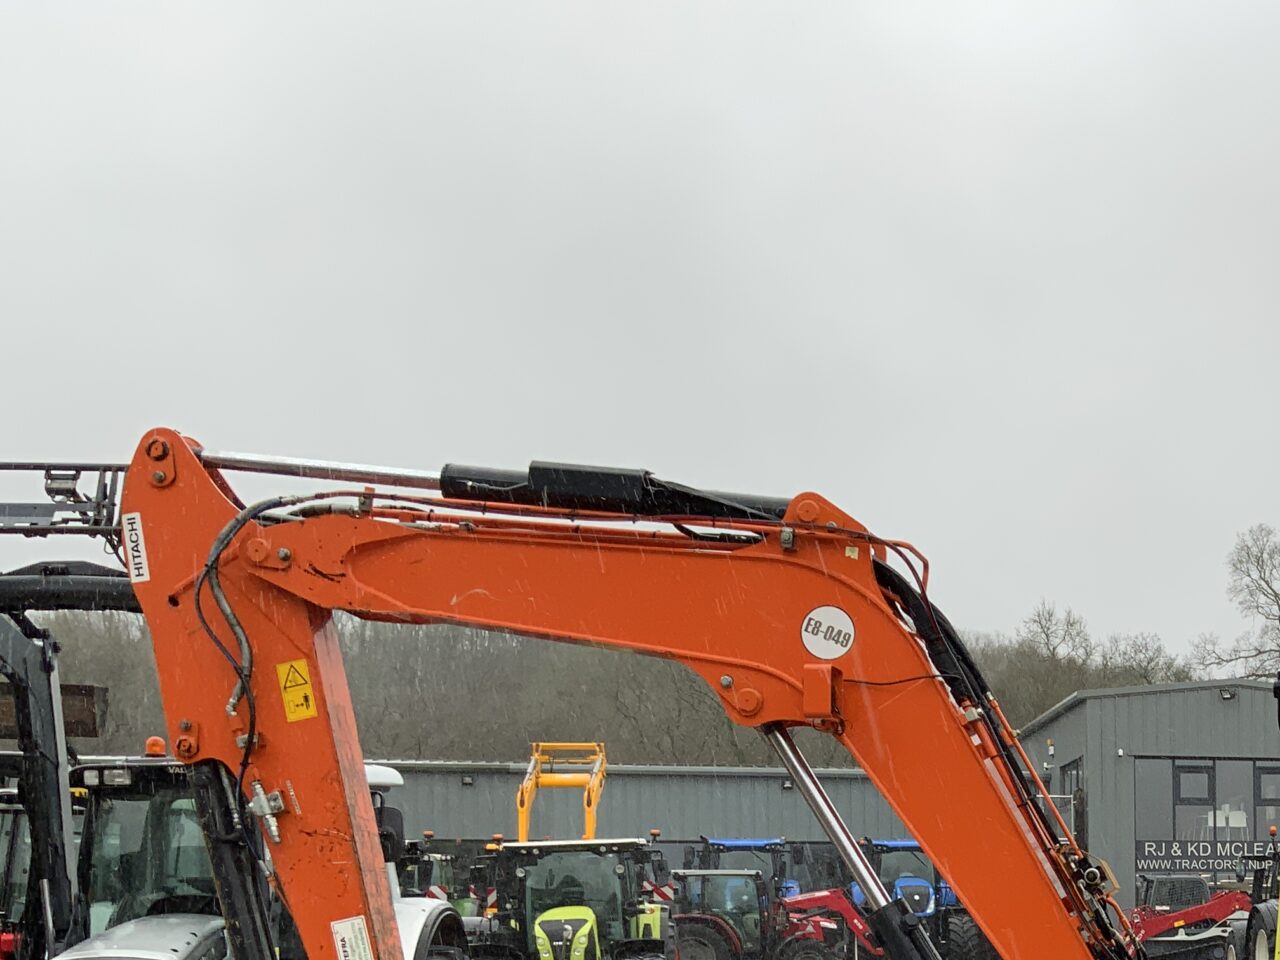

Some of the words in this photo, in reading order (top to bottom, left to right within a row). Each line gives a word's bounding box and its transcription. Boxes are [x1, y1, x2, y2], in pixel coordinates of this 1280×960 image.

[127, 517, 144, 577] HITACHI
[804, 617, 851, 648] E8-049
[1145, 843, 1165, 856] RJ
[1171, 843, 1182, 856] &
[1187, 843, 1211, 856] KD
[1137, 860, 1273, 870] WWW.TRACTORSNDP
